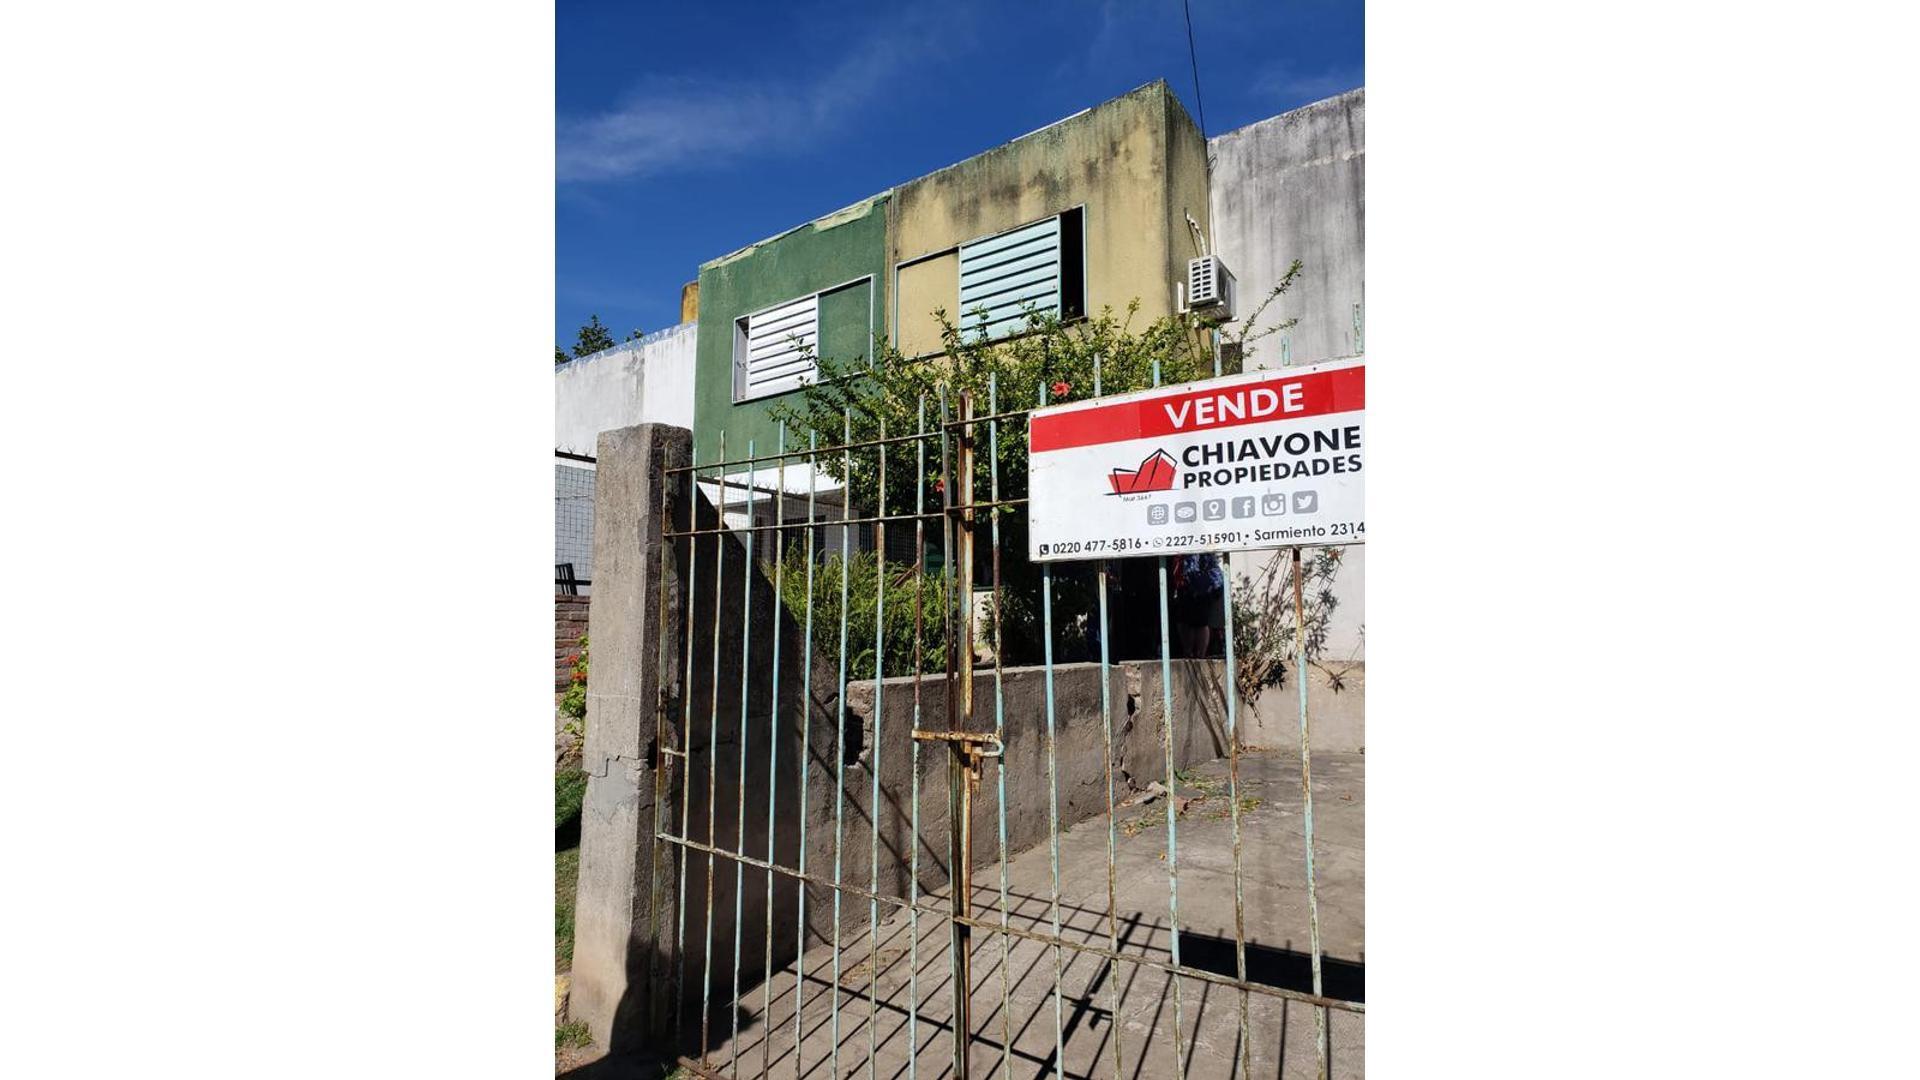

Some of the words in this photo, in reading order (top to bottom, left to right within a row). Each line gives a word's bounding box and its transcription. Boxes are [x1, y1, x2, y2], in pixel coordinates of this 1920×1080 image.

[1164, 382, 1305, 430] VENDE
[1181, 425, 1362, 468] CHIAVONE
[1183, 454, 1363, 489] PROPIEDADES
[1053, 541, 1081, 555] 0220
[1084, 537, 1142, 552] 477-5816
[1165, 531, 1242, 548] 2227-515901
[1254, 524, 1327, 542] Sarmiento
[1330, 521, 1365, 536] 2314
